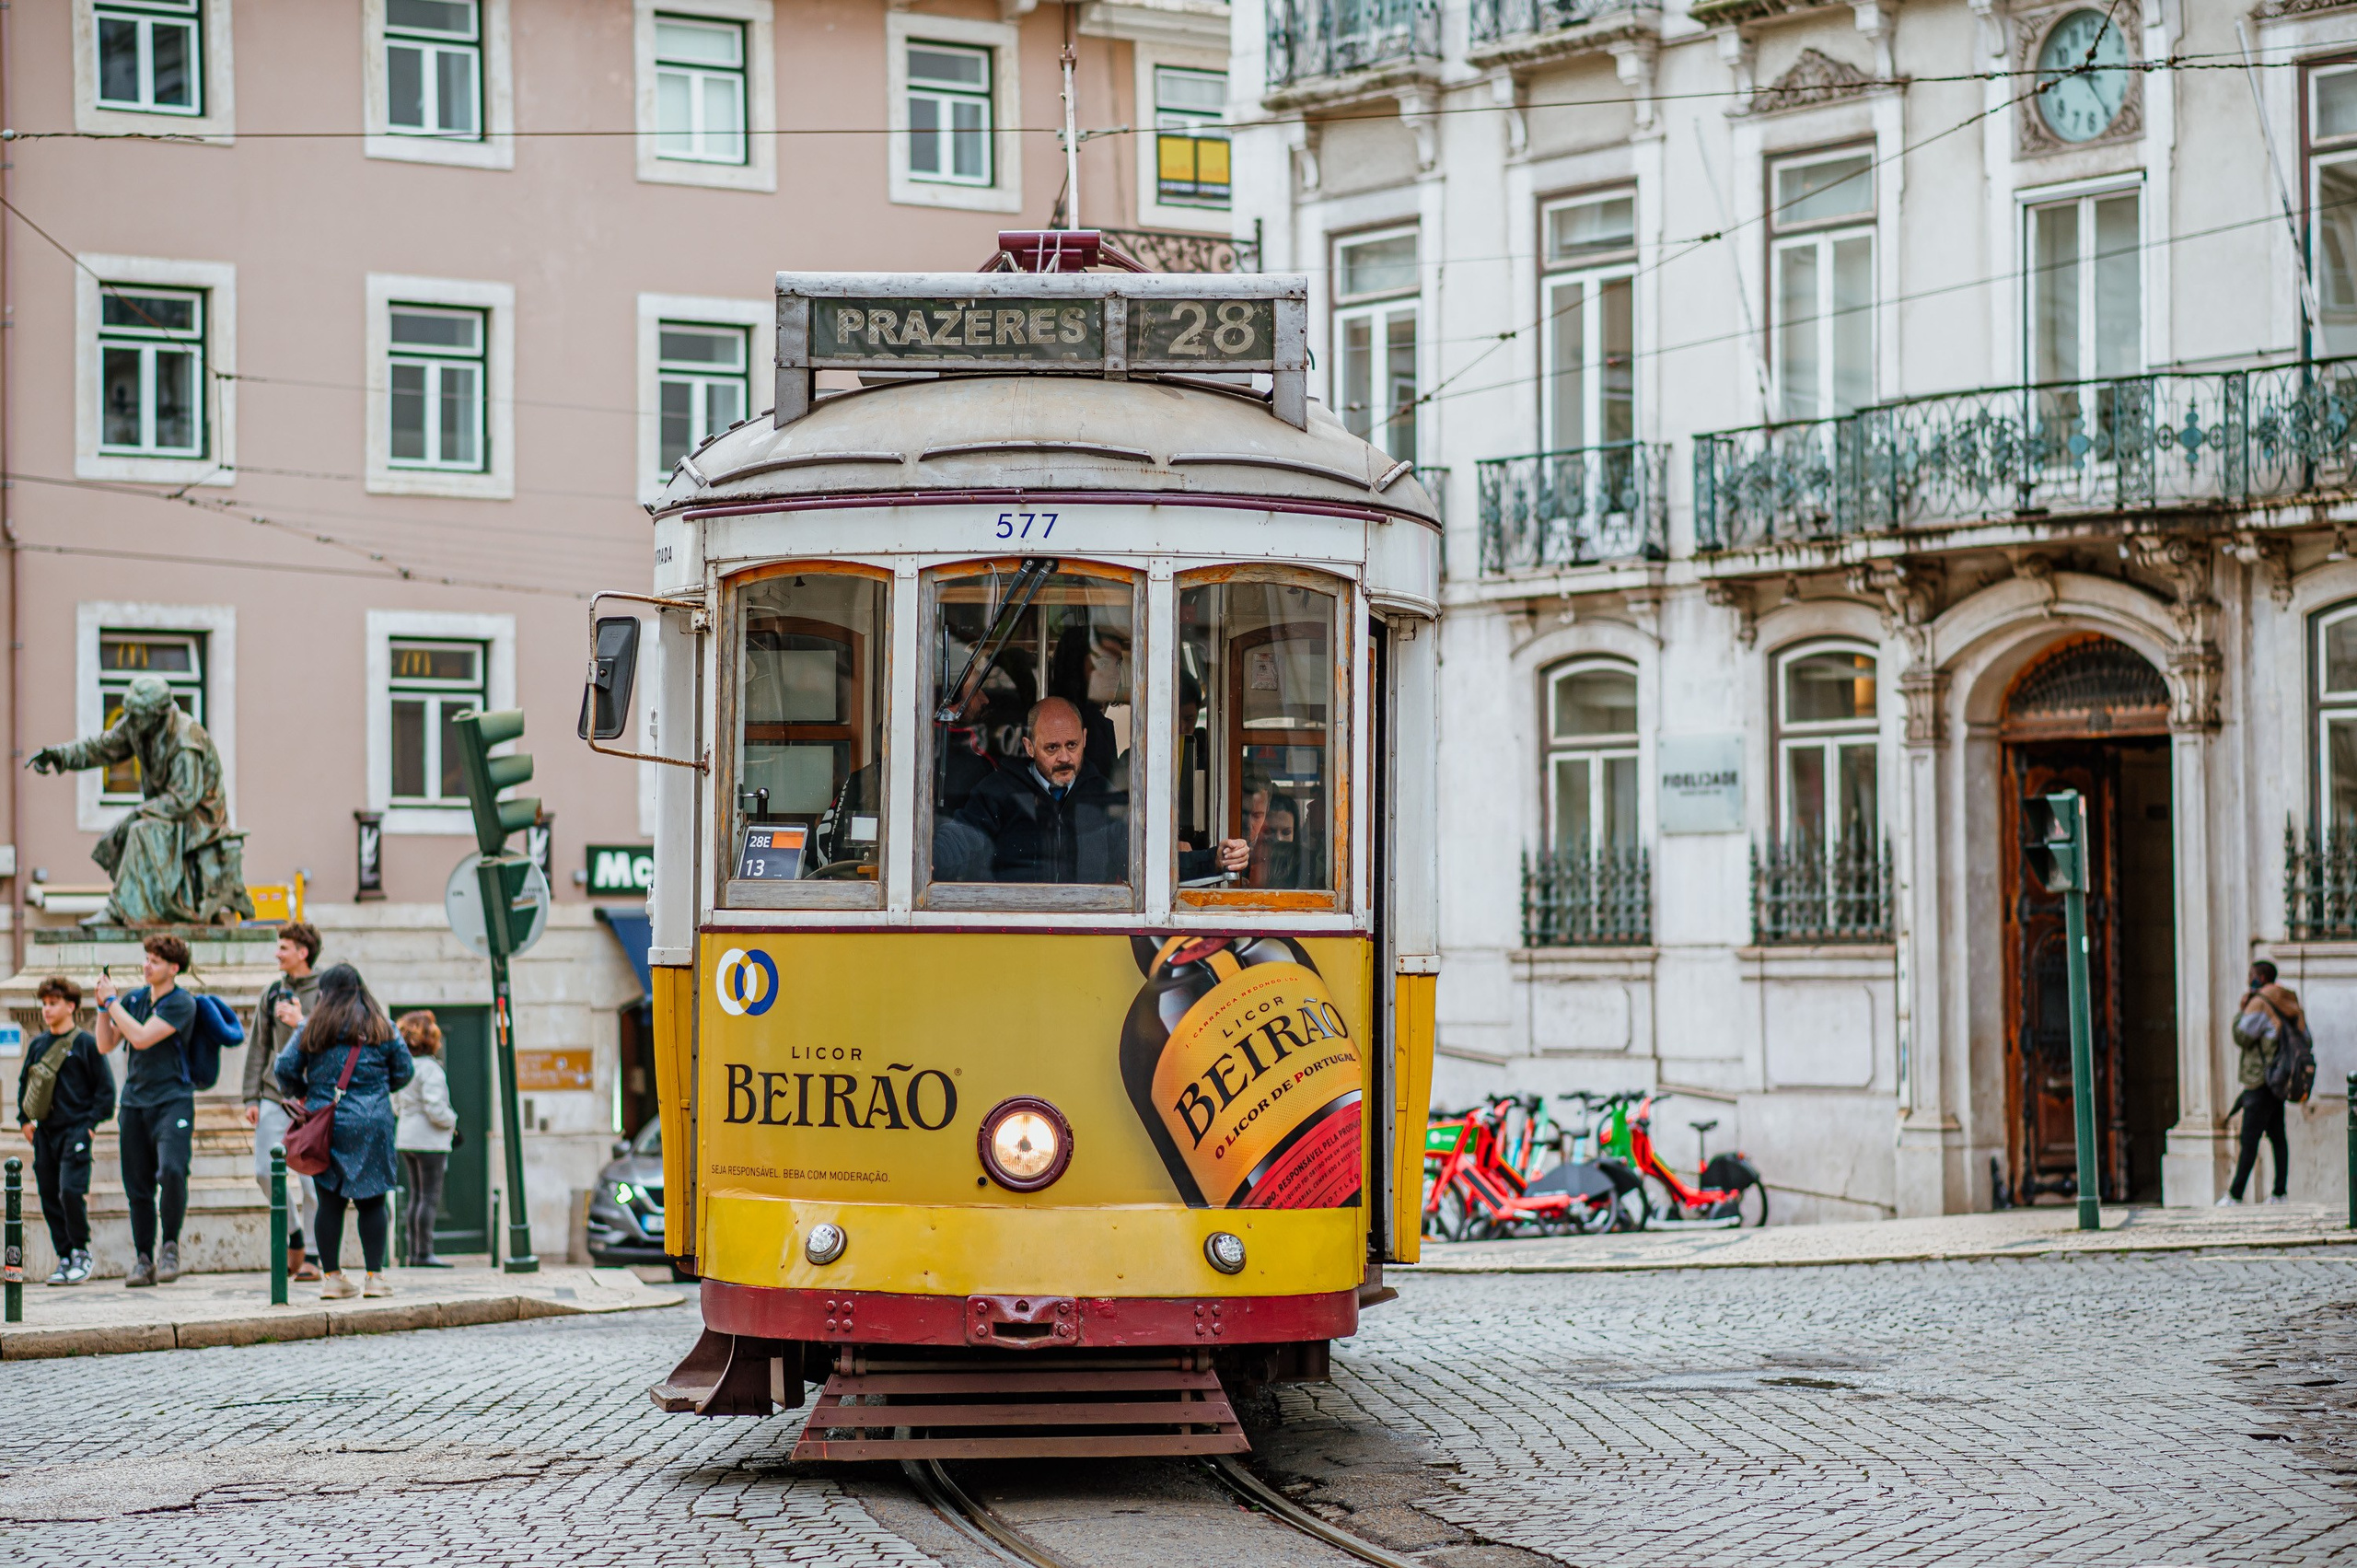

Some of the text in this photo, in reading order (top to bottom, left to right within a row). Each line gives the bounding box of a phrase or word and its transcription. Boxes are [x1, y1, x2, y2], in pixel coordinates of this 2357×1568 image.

[836, 300, 1256, 355] PRAZERES 28
[995, 512, 1060, 540] 577
[749, 835, 772, 848] 28E
[746, 859, 766, 877] 13
[1192, 997, 1237, 1039] CARRANCA
[1240, 978, 1282, 997] REDONDO
[1222, 995, 1284, 1039] LICOR
[791, 1046, 863, 1061] LICOR
[1173, 997, 1349, 1151] BEIRÃO
[723, 1063, 958, 1132] BEIRÃO
[1214, 1052, 1356, 1160] O LICOR DE PORTUGAL
[711, 1164, 891, 1184] SEJA RESPONSÁVEL. BEBA COM MODERAÇÃO.
[1277, 1146, 1323, 1192] RESPONSÁVEL
[1322, 1133, 1339, 1151] PELA
